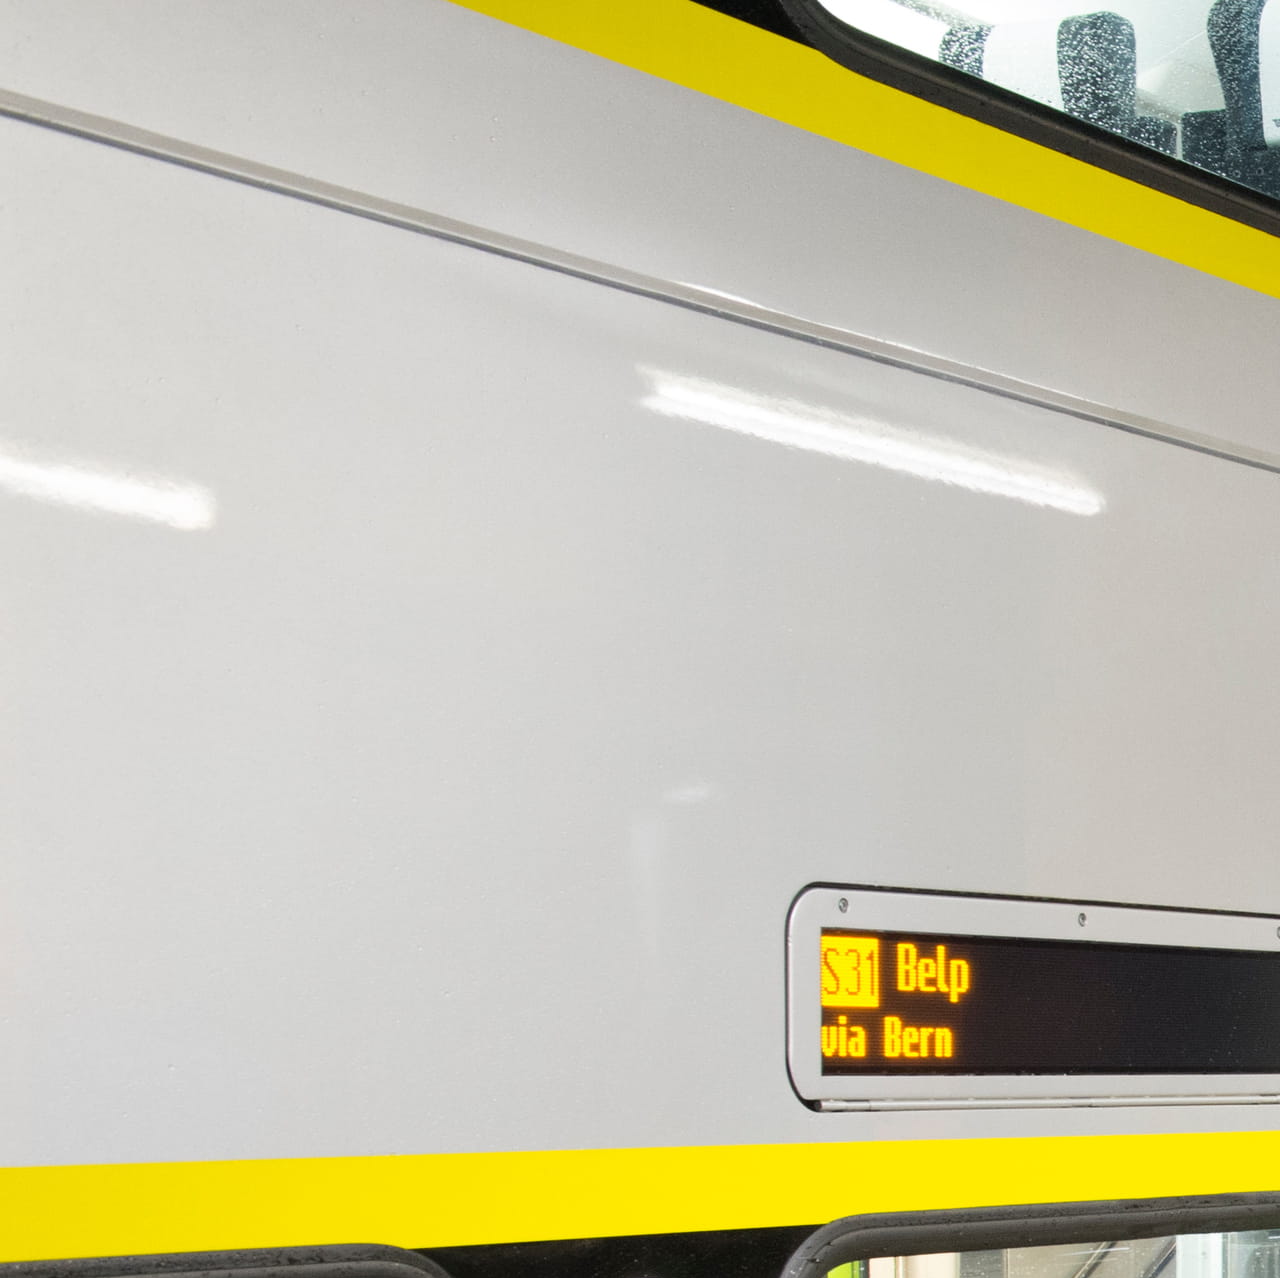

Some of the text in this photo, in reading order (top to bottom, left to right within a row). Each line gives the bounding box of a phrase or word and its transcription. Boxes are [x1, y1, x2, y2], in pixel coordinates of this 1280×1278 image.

[824, 942, 970, 1003] S31 Belp
[821, 1015, 953, 1058] via Bern
